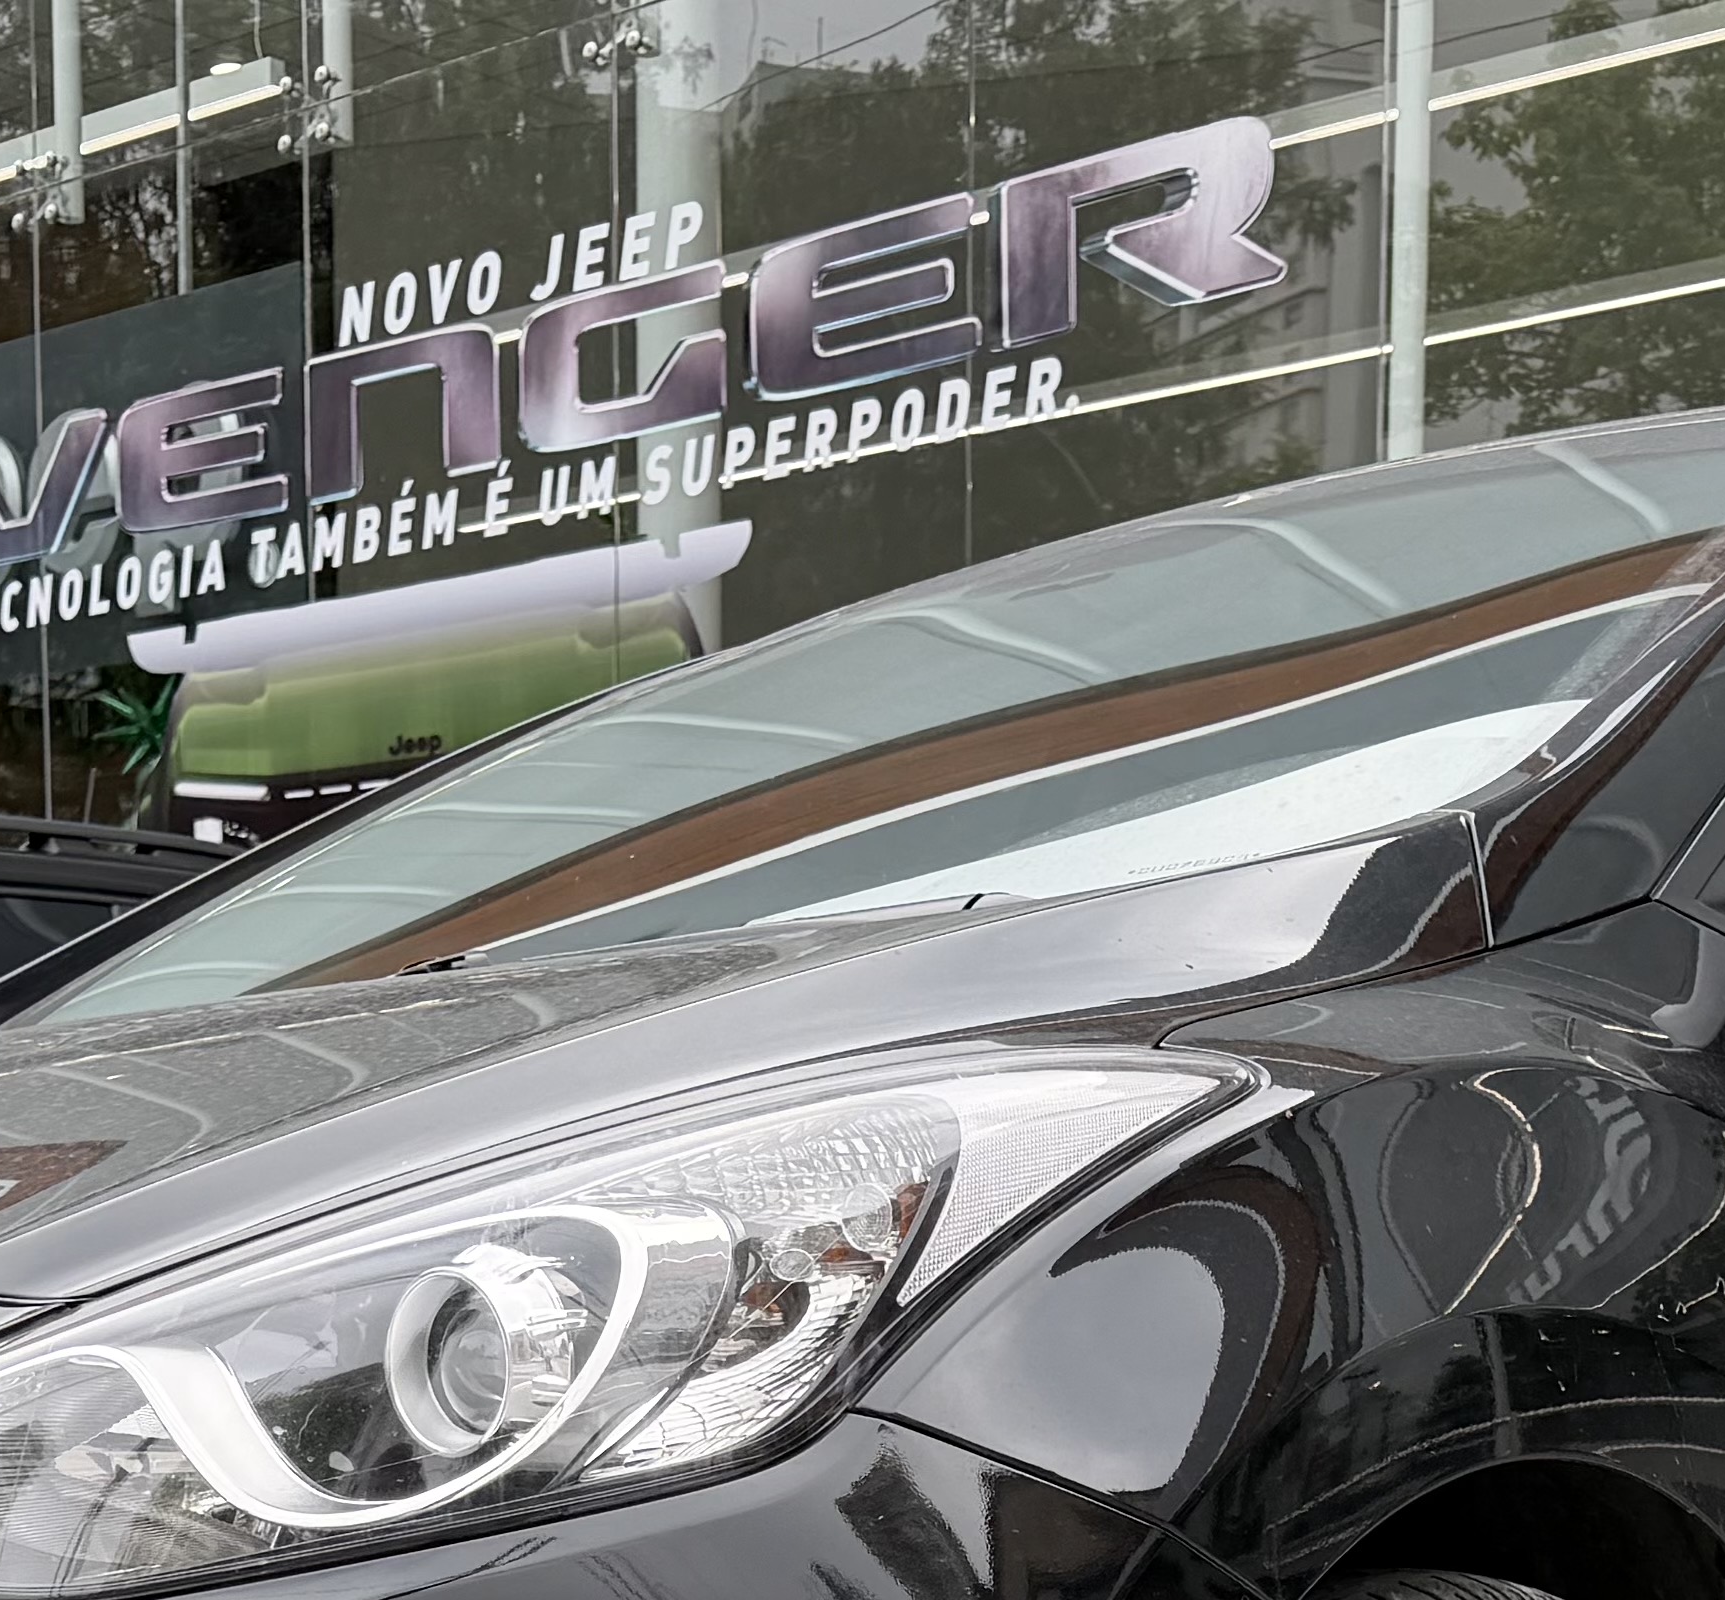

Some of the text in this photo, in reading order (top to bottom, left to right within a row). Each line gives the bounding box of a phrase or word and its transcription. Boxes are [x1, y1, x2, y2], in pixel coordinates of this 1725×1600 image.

[338, 201, 703, 346] NOVO JEEP
[250, 478, 459, 582] TAMBÉM
[485, 459, 515, 536] É
[538, 455, 617, 526] UM
[642, 356, 1081, 506] SUPERPODER.
[388, 733, 442, 757] Jeep
